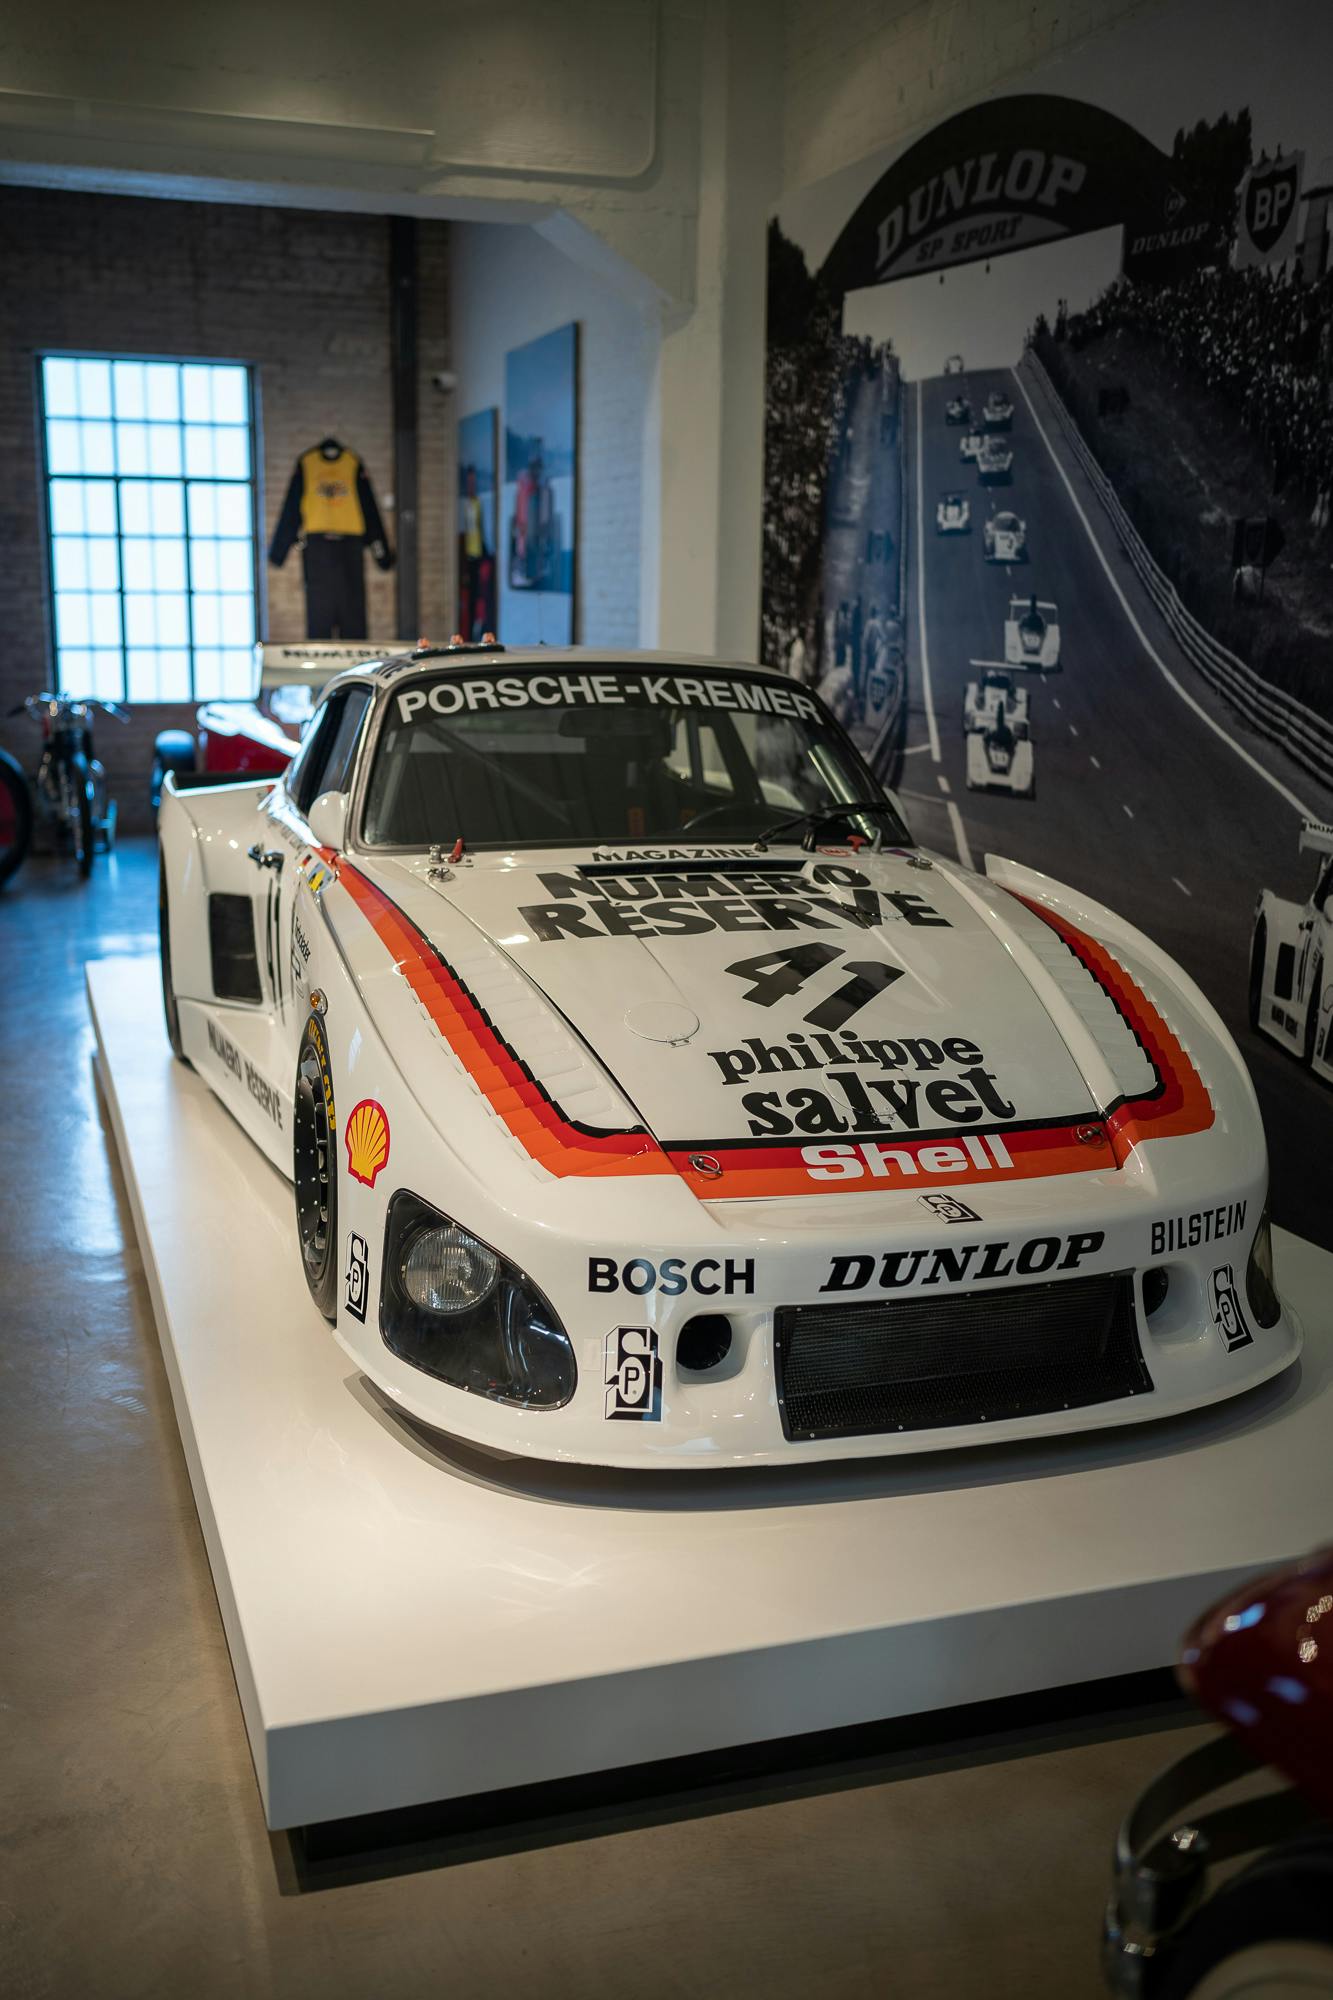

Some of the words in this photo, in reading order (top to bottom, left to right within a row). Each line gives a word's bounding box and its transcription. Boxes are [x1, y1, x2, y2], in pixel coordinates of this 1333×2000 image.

[874, 149, 1087, 271] DUNLOP
[1252, 180, 1292, 233] BP
[916, 238, 944, 263] SP
[951, 215, 1023, 252] SPORT
[1131, 222, 1211, 255] DUNLOP
[397, 676, 824, 724] PORSCHE-KREMER
[593, 848, 761, 862] MAGAZINE
[517, 890, 954, 942] RÉSERVÉ
[724, 942, 906, 1032] 41
[707, 1030, 984, 1085] philippe
[741, 1067, 1016, 1136] salvet
[801, 1134, 1014, 1180] Shell
[1151, 1200, 1247, 1255] BILSTEIN
[588, 1257, 755, 1295] BOSCH
[819, 1231, 1105, 1293] DUNLOP
